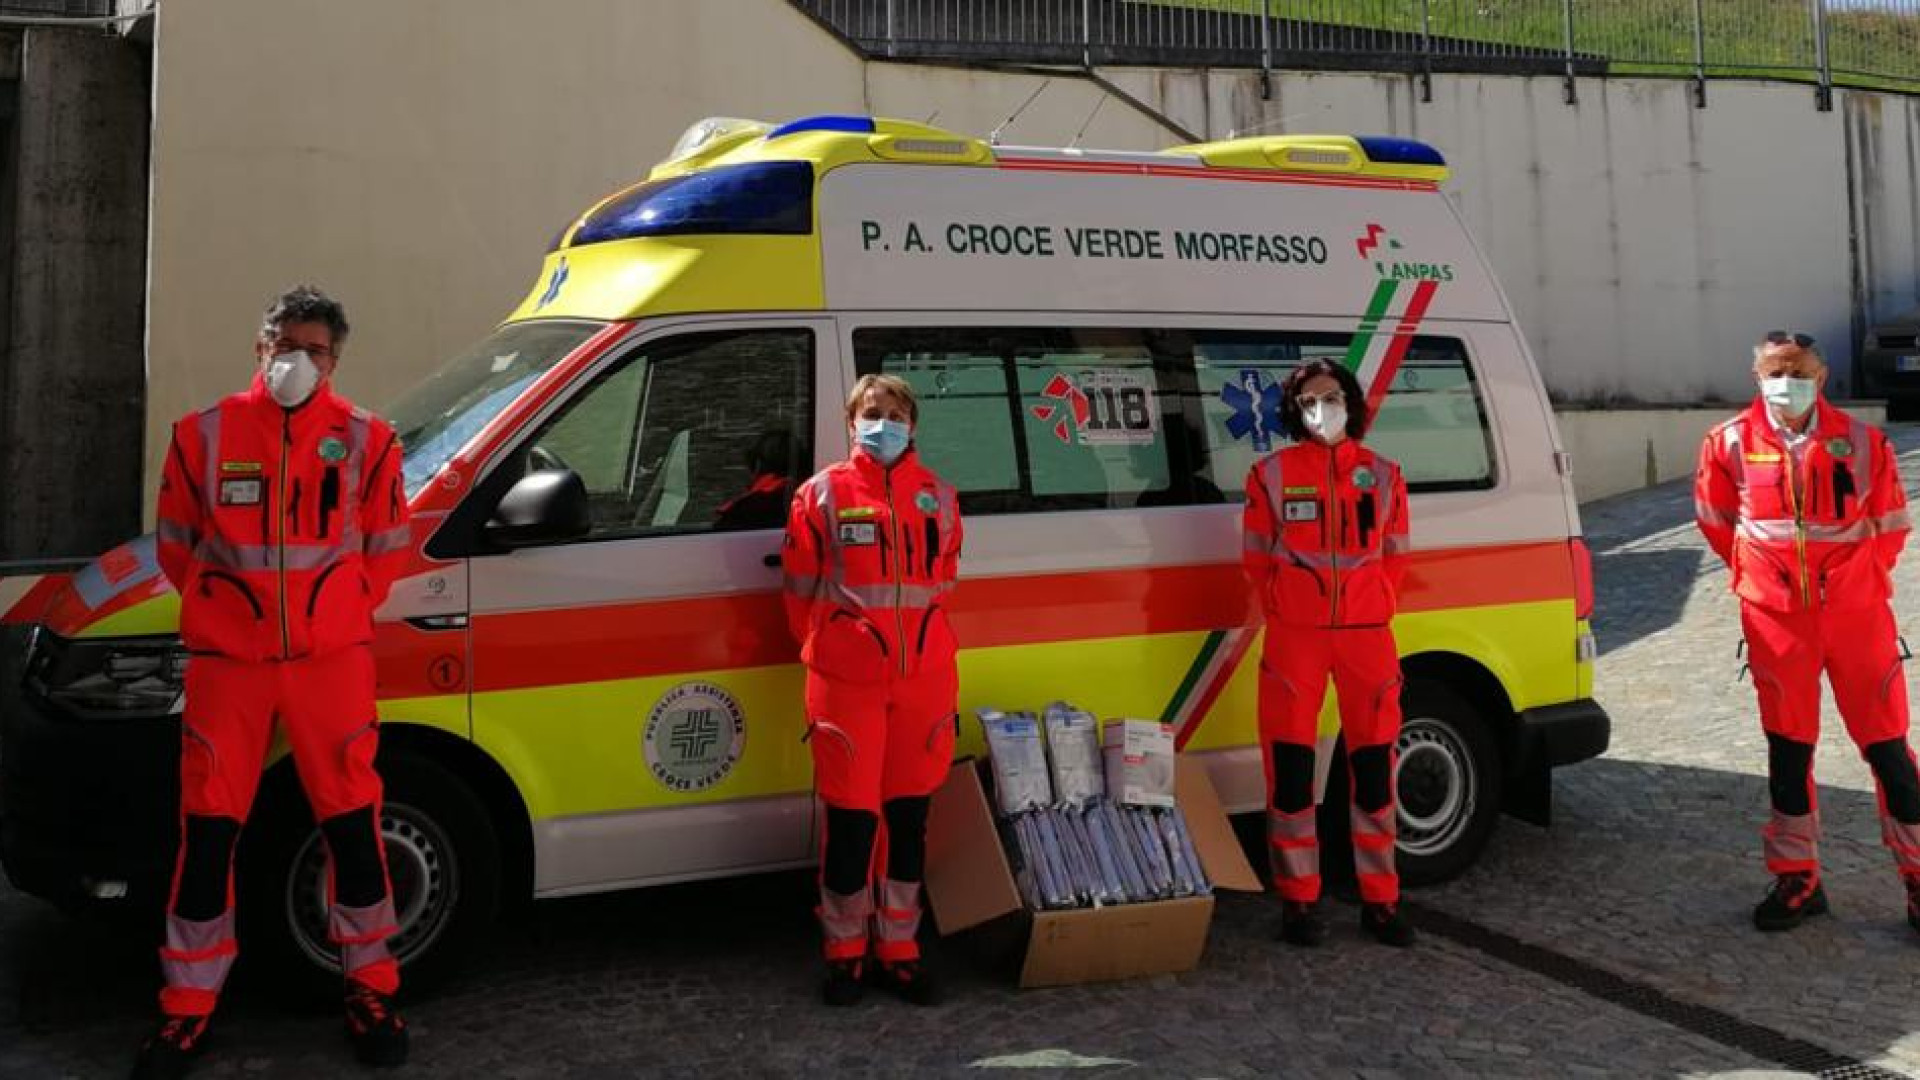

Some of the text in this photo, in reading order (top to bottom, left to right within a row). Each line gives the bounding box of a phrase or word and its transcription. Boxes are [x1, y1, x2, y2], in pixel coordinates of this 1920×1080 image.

[862, 220, 1327, 264] P. A. CROCE VERDE MORFASSO
[1391, 262, 1454, 281] ANPAS
[1082, 387, 1150, 430] 118
[652, 755, 736, 790] CROCE VERDE
